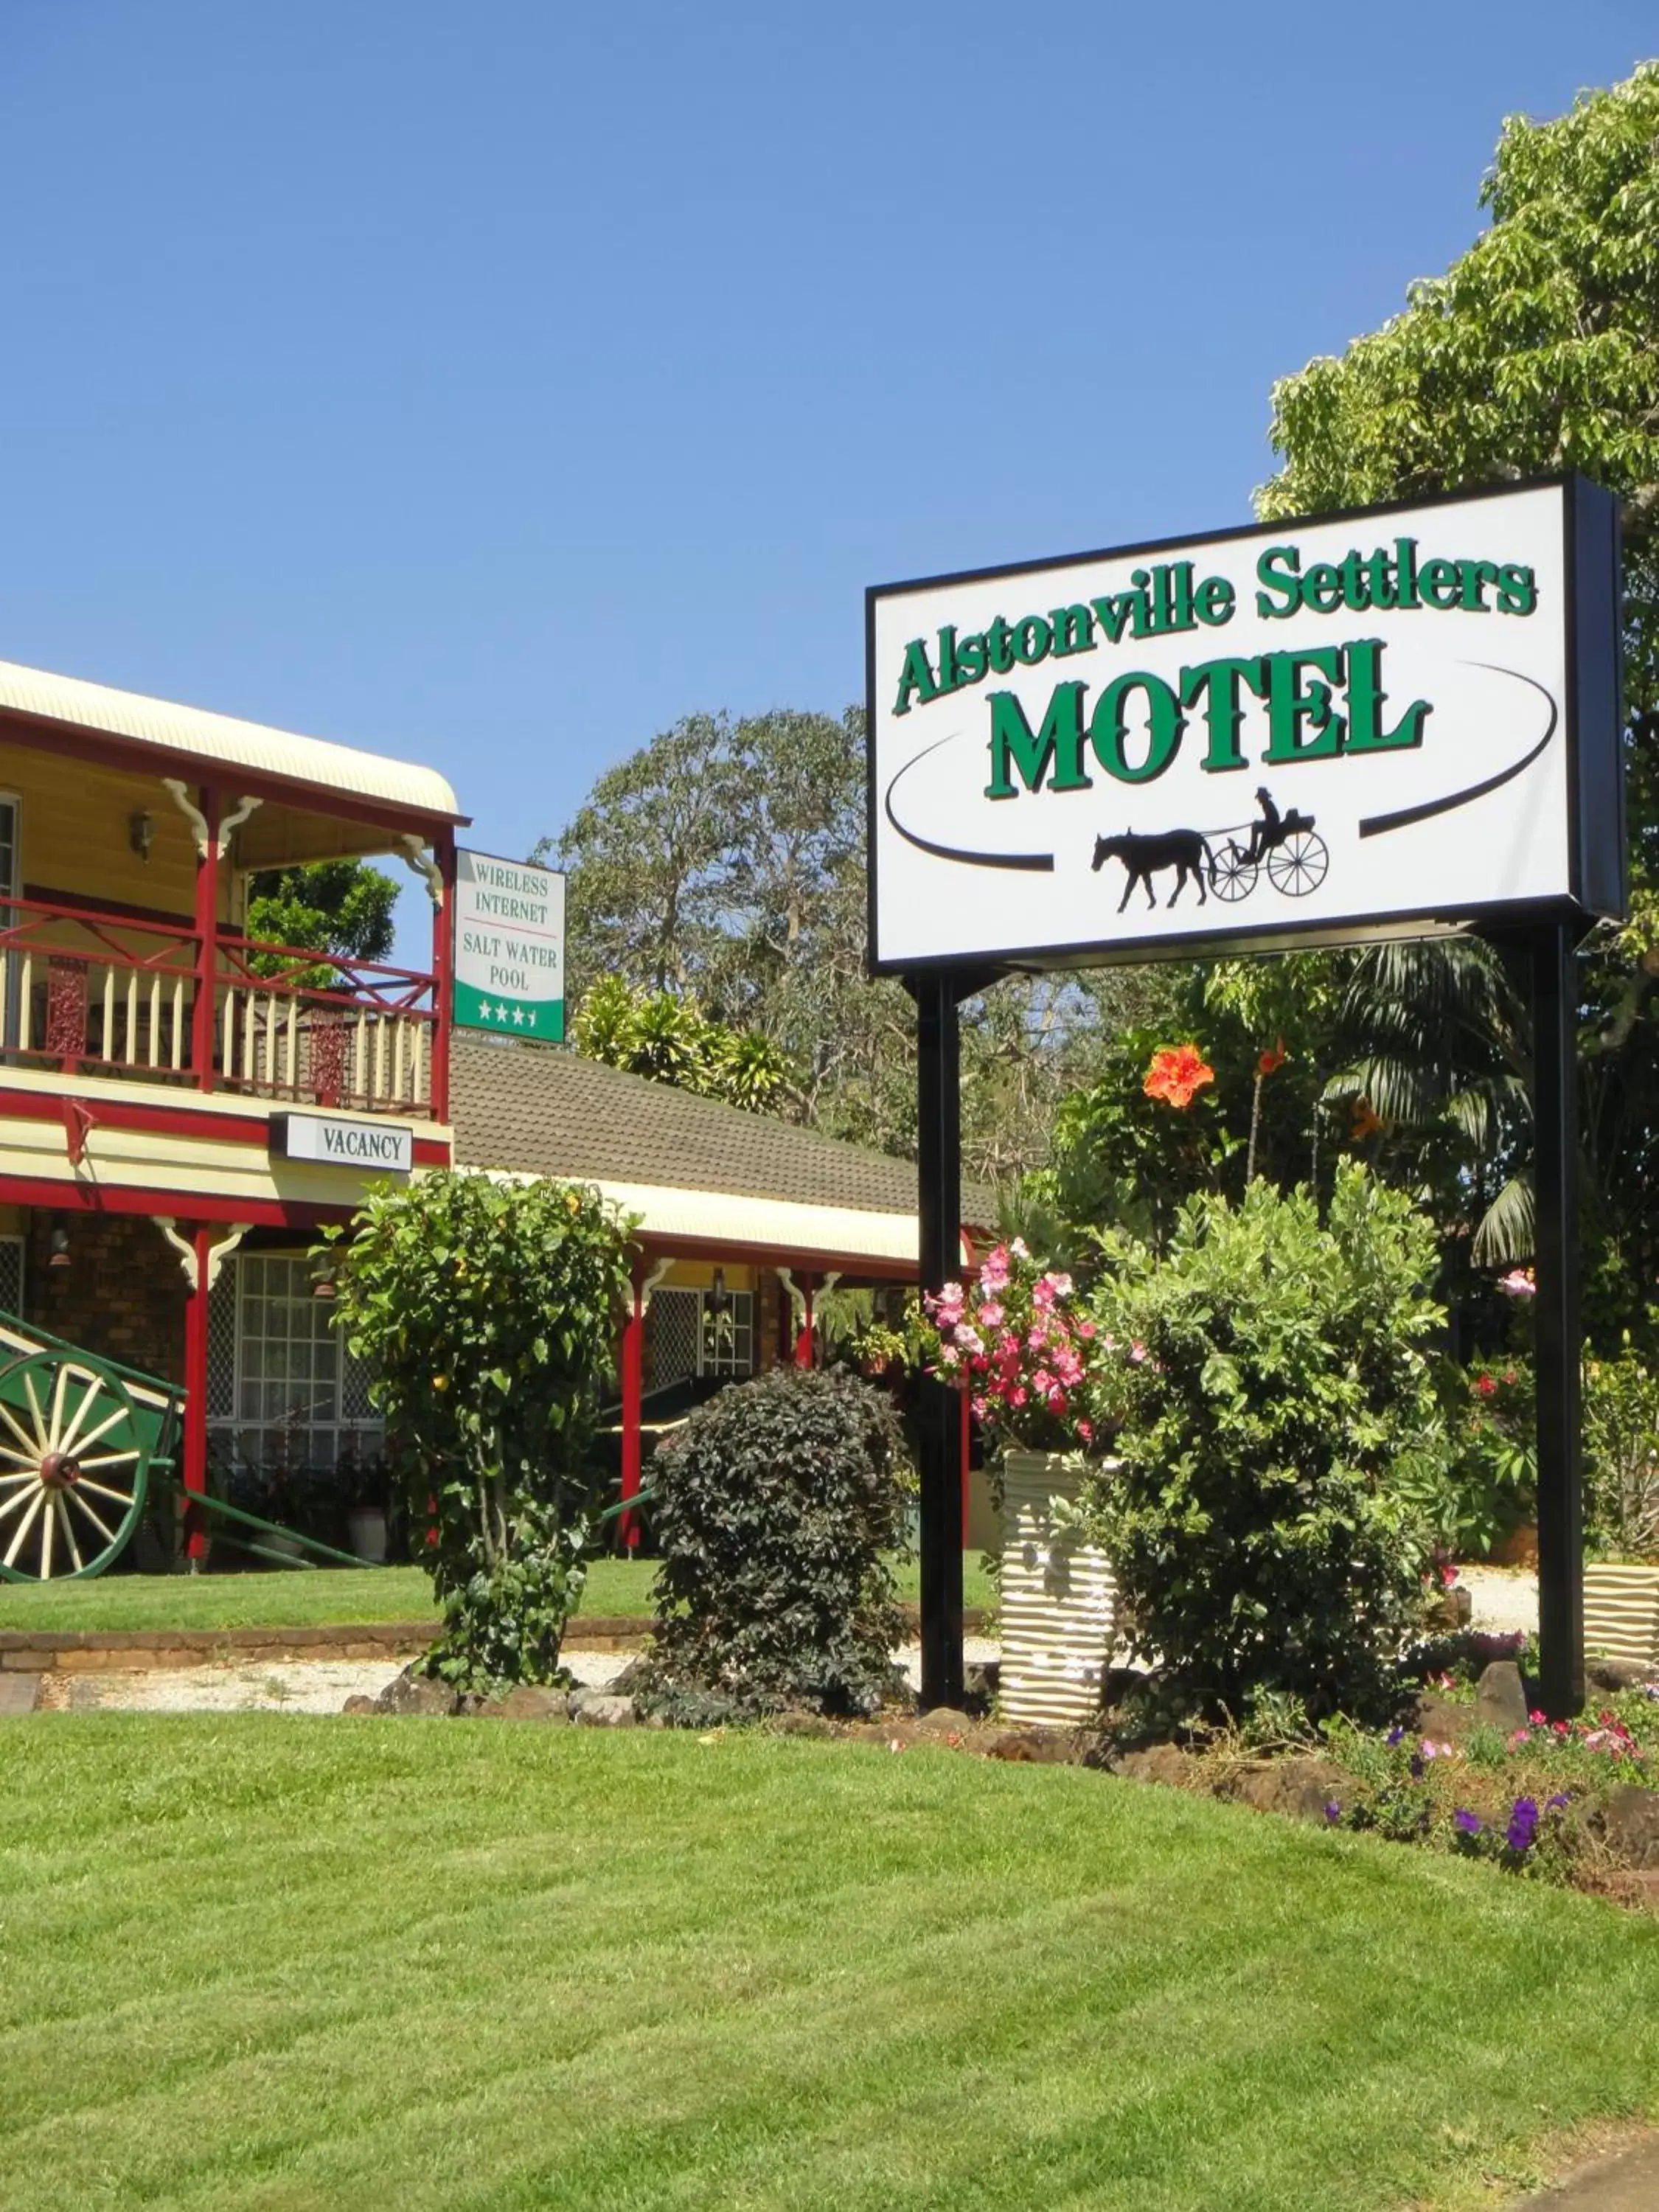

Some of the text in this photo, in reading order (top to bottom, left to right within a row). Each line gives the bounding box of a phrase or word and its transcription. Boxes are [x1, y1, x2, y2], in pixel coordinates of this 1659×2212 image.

[892, 538, 1537, 717] Alstonville Settlers
[984, 638, 1433, 801] MOTEL
[476, 863, 548, 897] WIRELESS
[476, 891, 548, 925] INTERNET
[463, 932, 557, 969] SALT WATER
[490, 964, 529, 991] POOL
[324, 1127, 404, 1161] VACANCY
